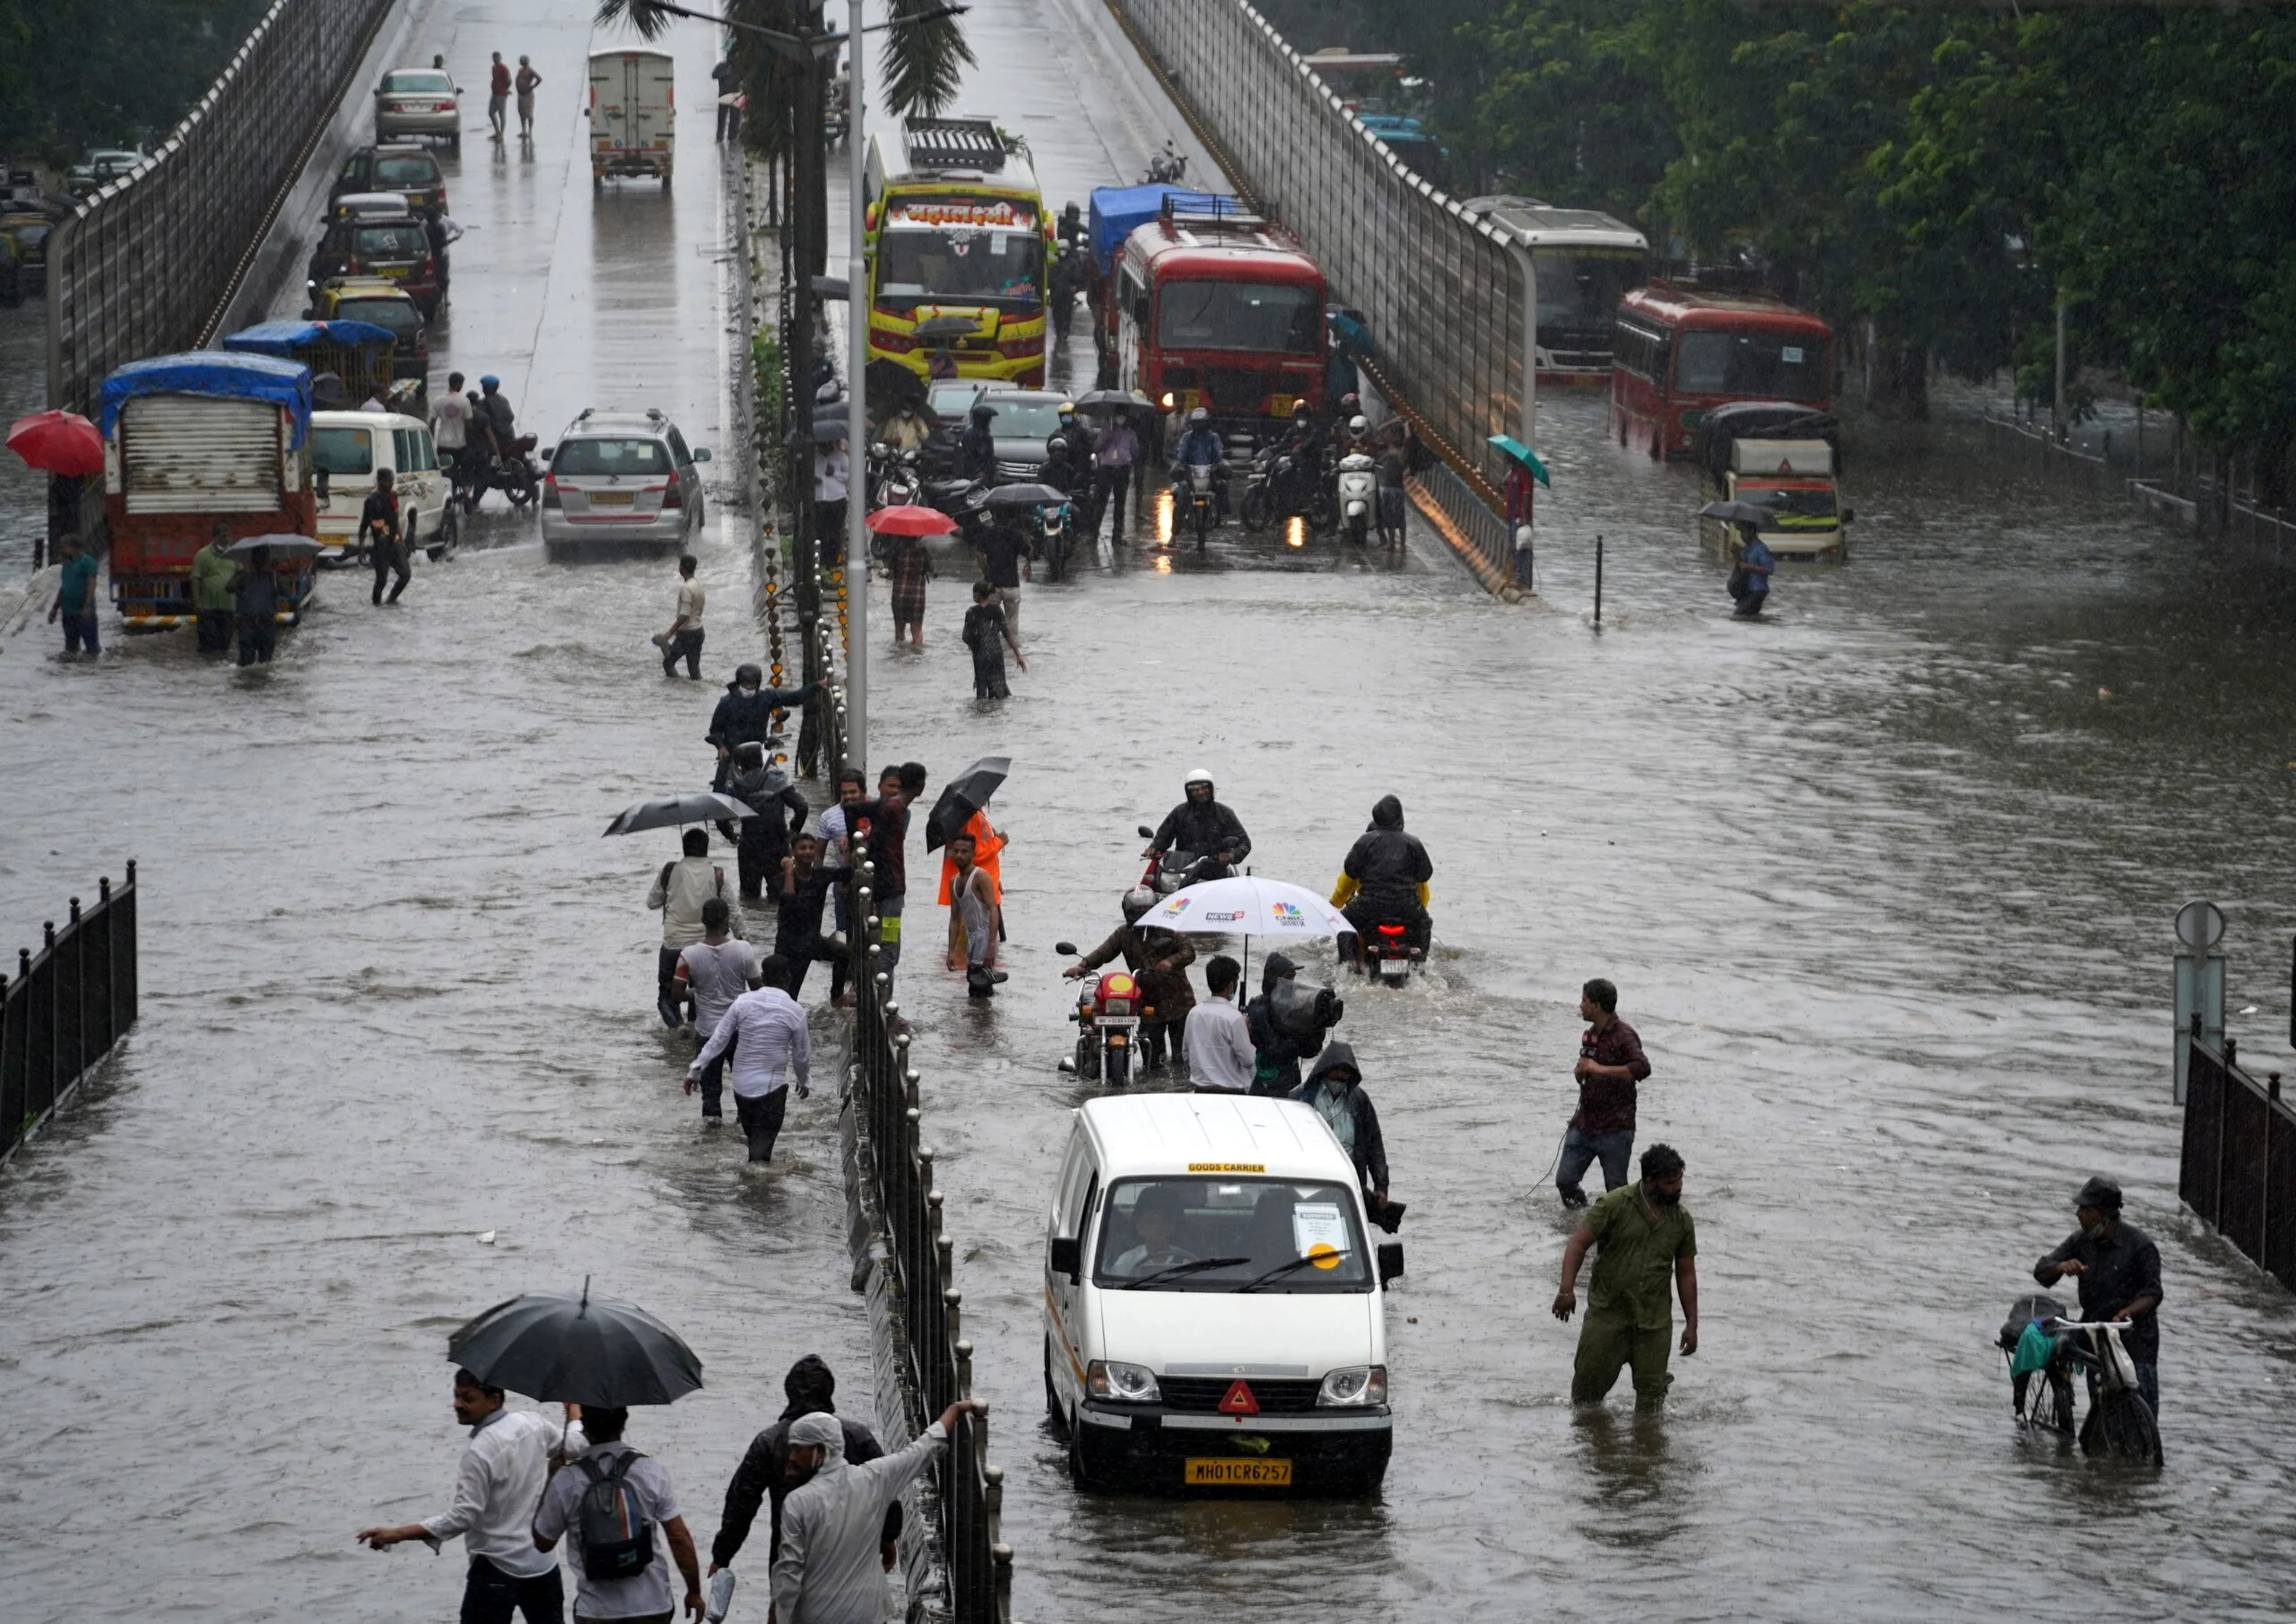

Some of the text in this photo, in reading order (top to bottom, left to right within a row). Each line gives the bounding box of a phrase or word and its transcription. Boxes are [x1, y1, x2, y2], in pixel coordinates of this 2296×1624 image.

[906, 202, 1015, 226] महालक्ष्मी
[1188, 1163, 1265, 1173] GOODS CARRIER
